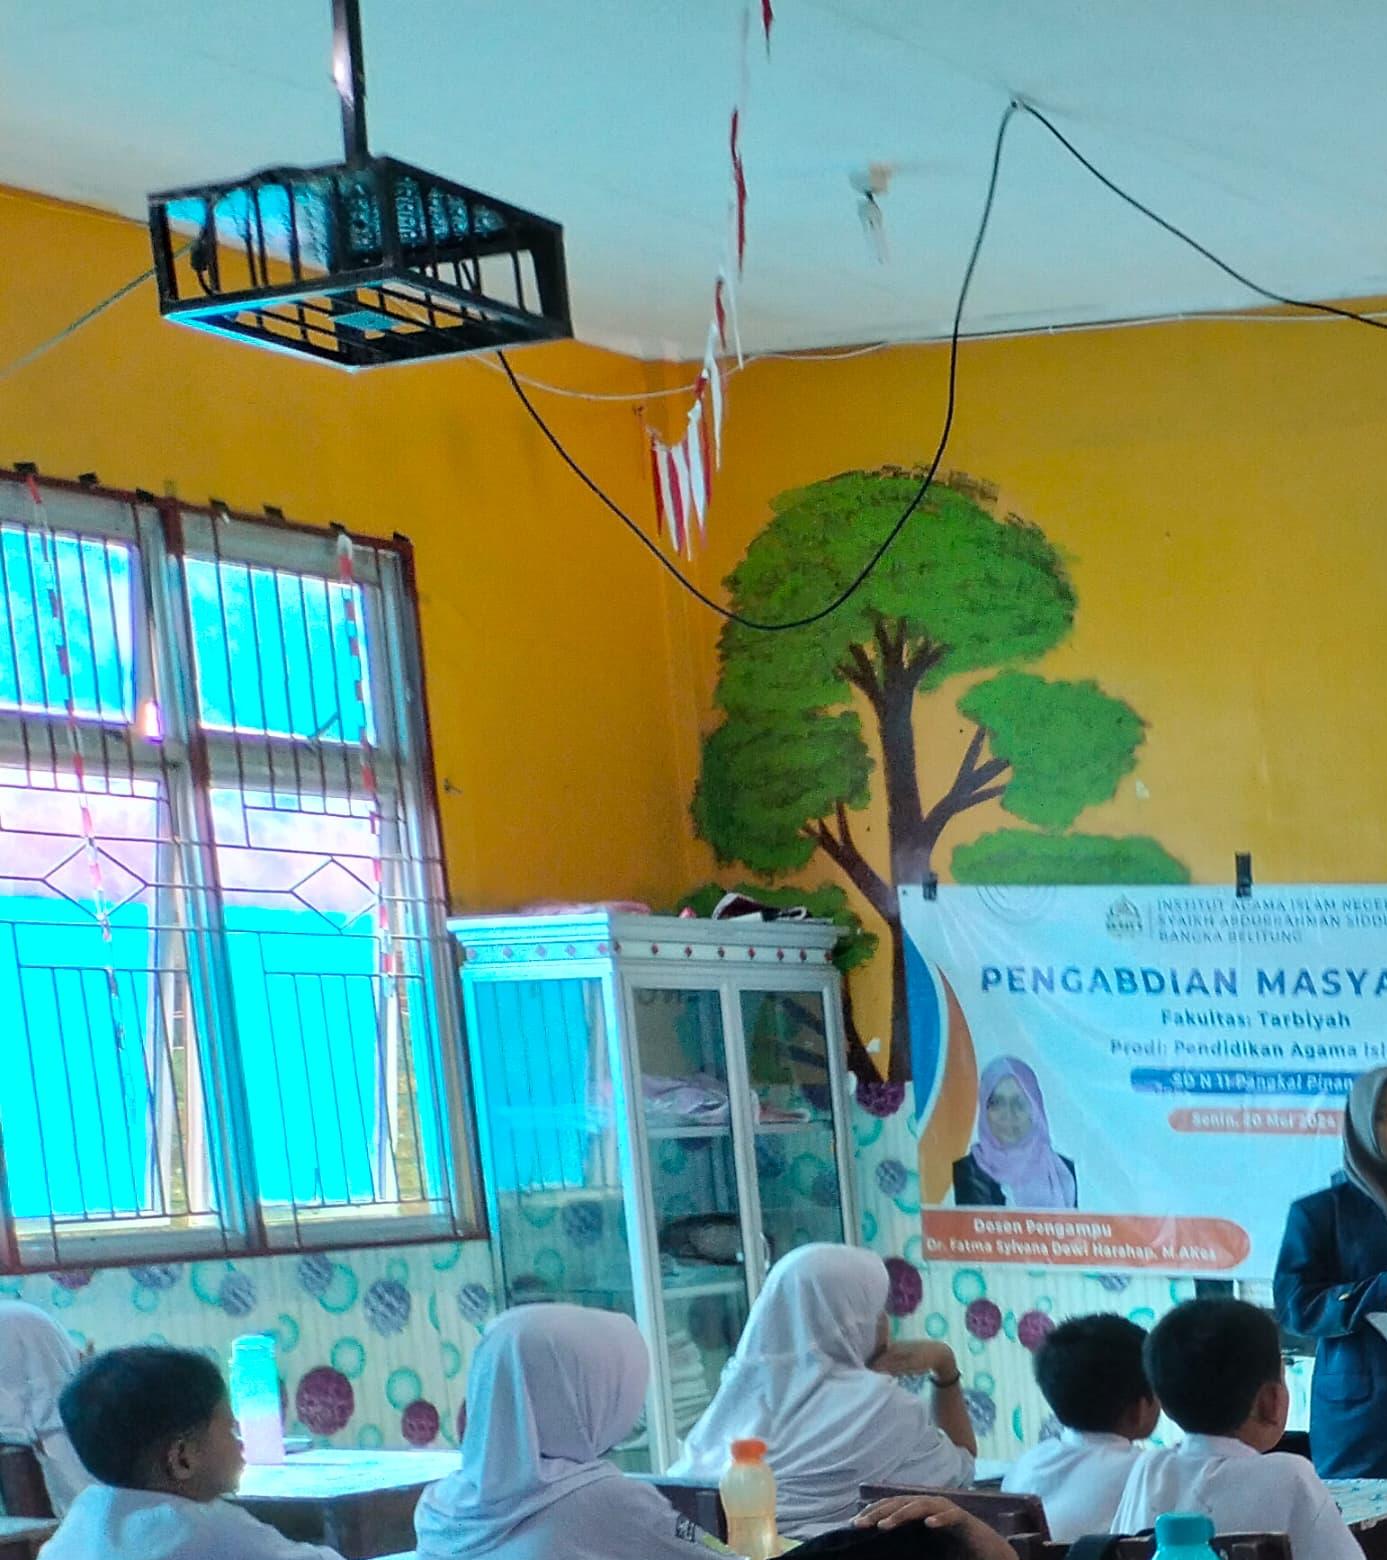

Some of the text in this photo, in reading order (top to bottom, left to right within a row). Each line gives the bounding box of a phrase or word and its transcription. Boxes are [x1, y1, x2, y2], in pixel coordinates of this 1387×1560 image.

[1157, 898, 1224, 912] INSTITUT
[1233, 898, 1287, 912] AGAMA
[1290, 897, 1336, 912] ISLAM
[1158, 914, 1215, 928] SYAIKH
[1159, 930, 1303, 944] BANGKA BELITUNG
[981, 966, 1238, 997] PENGABDIAN
[1160, 1008, 1352, 1031] Fakultas: Tarbiyah
[1110, 1038, 1168, 1056] Prodi:
[1174, 1039, 1284, 1058] Pendidikan
[1290, 1040, 1357, 1061] Agama
[1171, 1072, 1353, 1093] SD N 11 Pangkal Pinan
[973, 1217, 1113, 1239] Dosen Pengampu
[949, 1239, 993, 1253] Fatma
[995, 1240, 1049, 1257] Sylvana
[1051, 1241, 1089, 1257] Dewi
